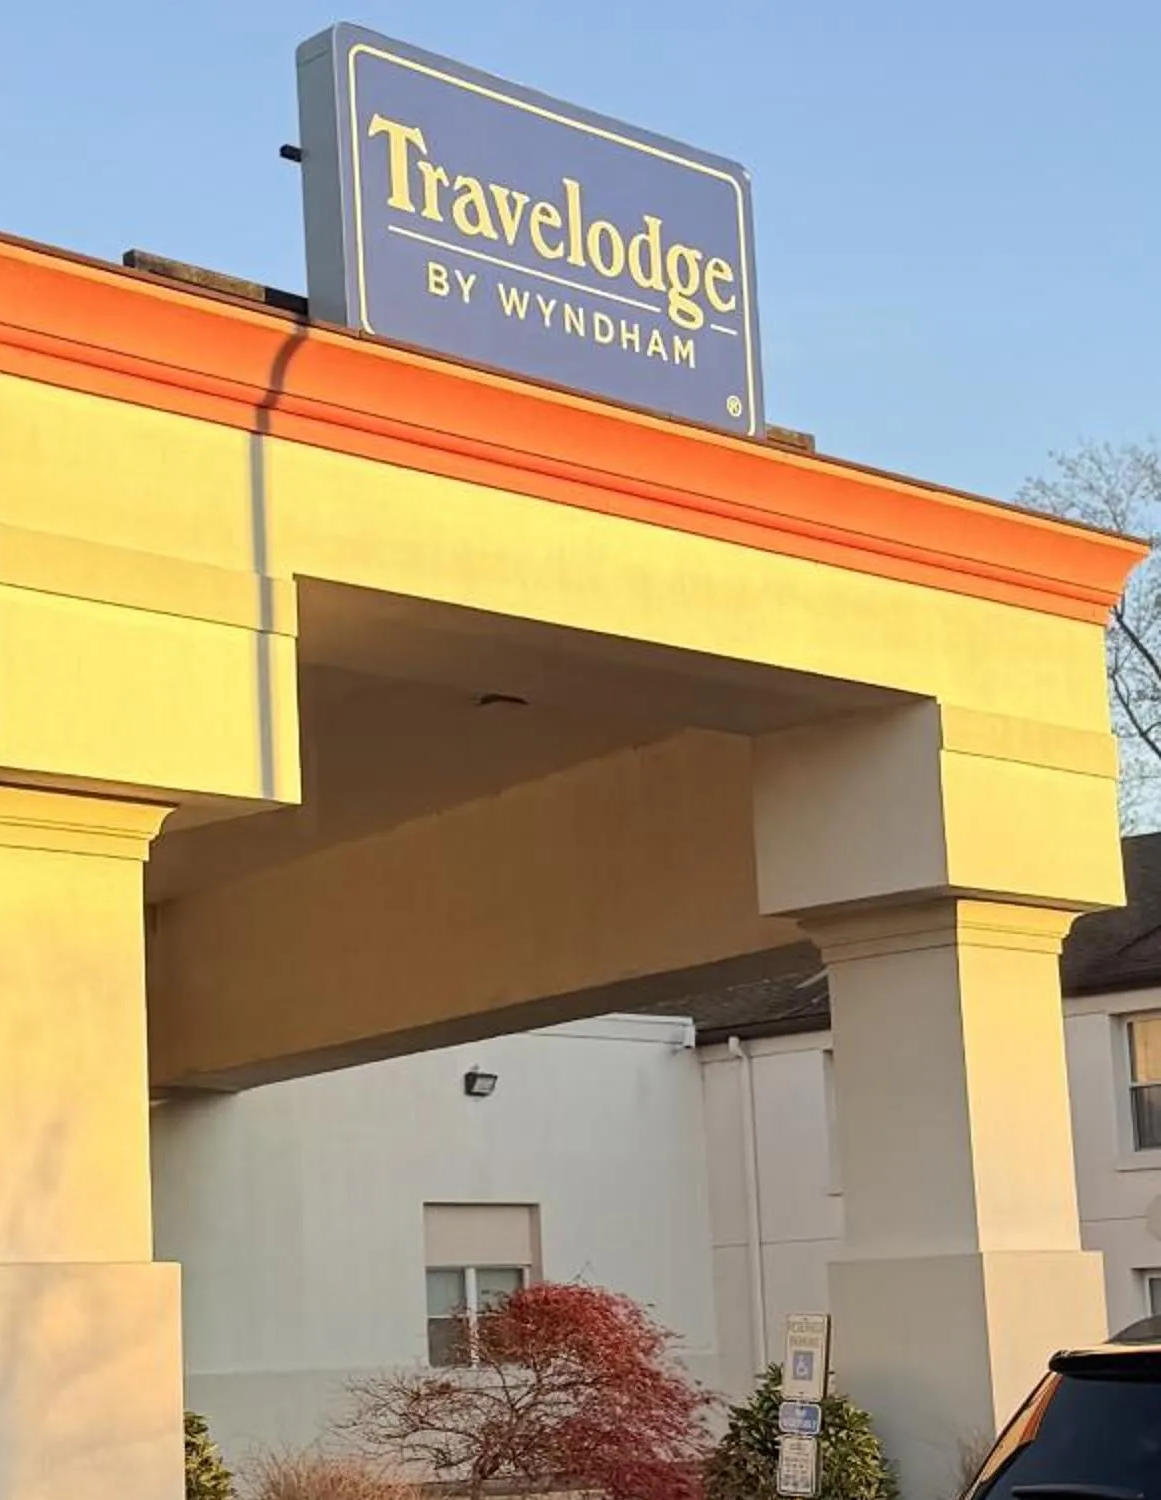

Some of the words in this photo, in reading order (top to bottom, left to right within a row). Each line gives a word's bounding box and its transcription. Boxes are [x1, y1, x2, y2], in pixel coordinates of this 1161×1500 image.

[368, 113, 736, 330] Travelodge
[427, 260, 477, 303] BY
[497, 282, 697, 369] WYNDHAM
